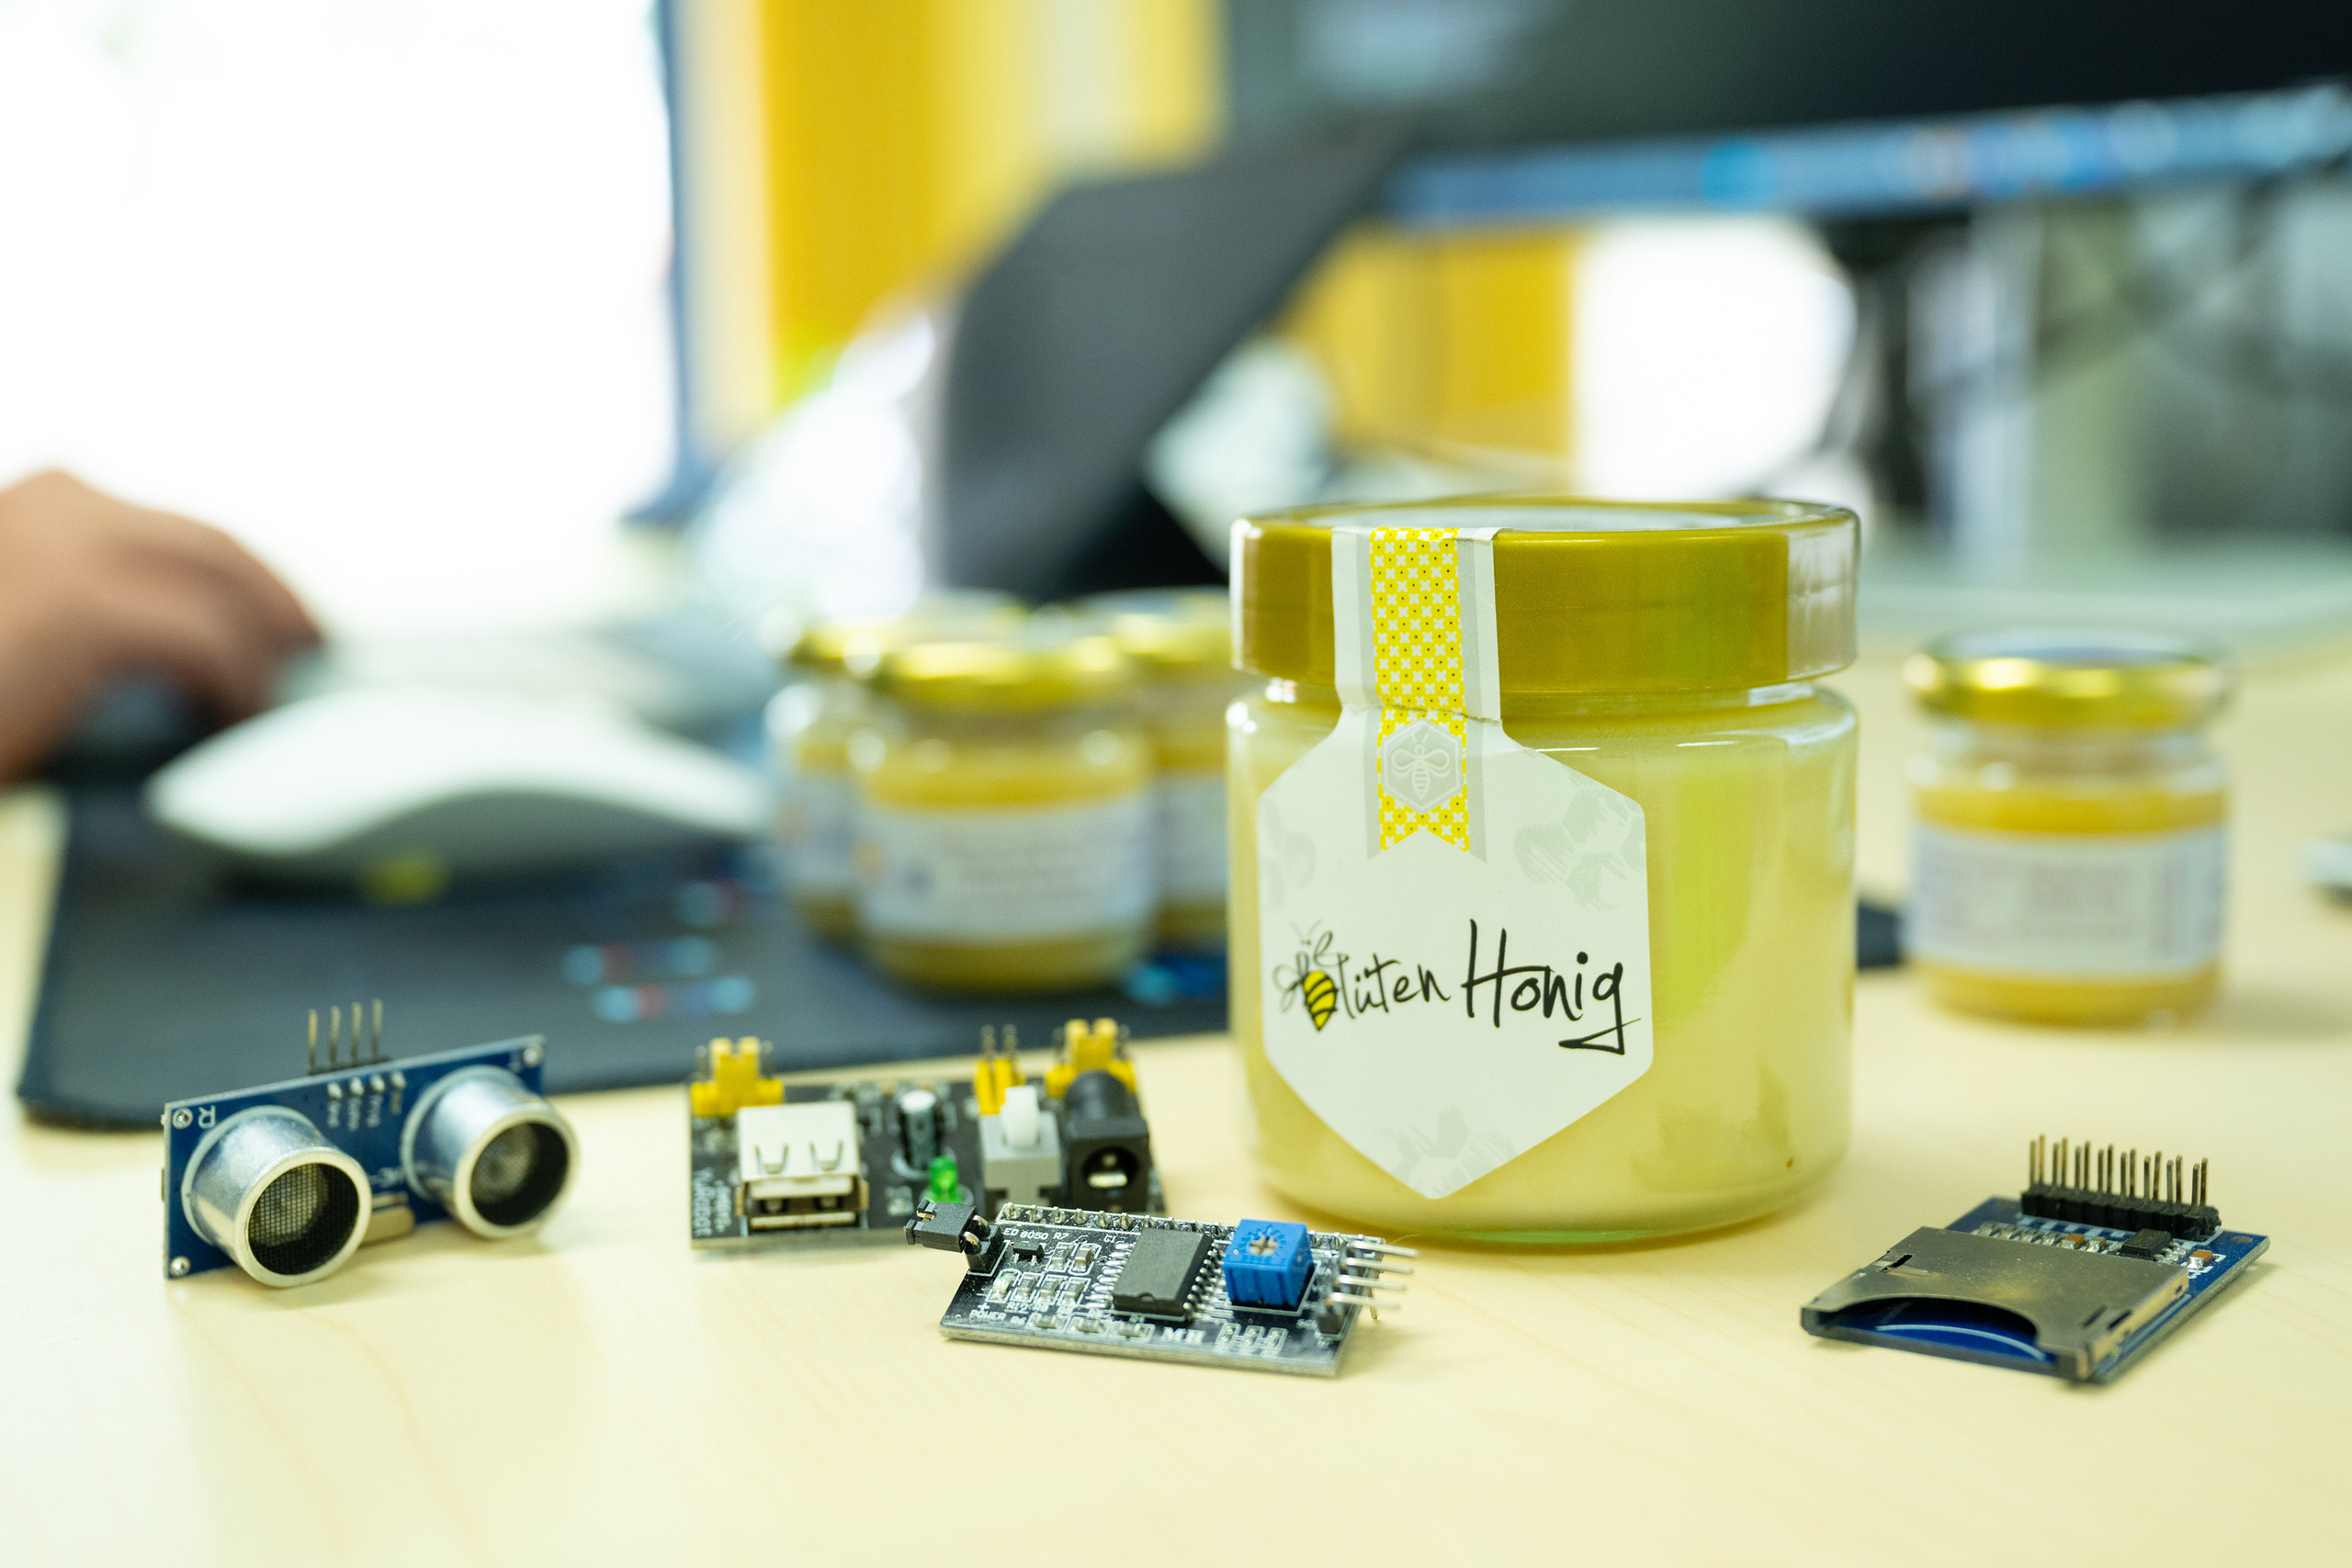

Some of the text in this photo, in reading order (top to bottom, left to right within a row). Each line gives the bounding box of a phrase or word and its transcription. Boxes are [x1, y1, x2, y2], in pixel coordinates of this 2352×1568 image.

[1461, 919, 1642, 1055] Honig
[197, 1104, 217, 1129] R
[1002, 1227, 1020, 1236] ED
[1020, 1230, 1049, 1240] 8050
[1053, 1232, 1069, 1240] R7
[968, 1309, 1007, 1321] POWER
